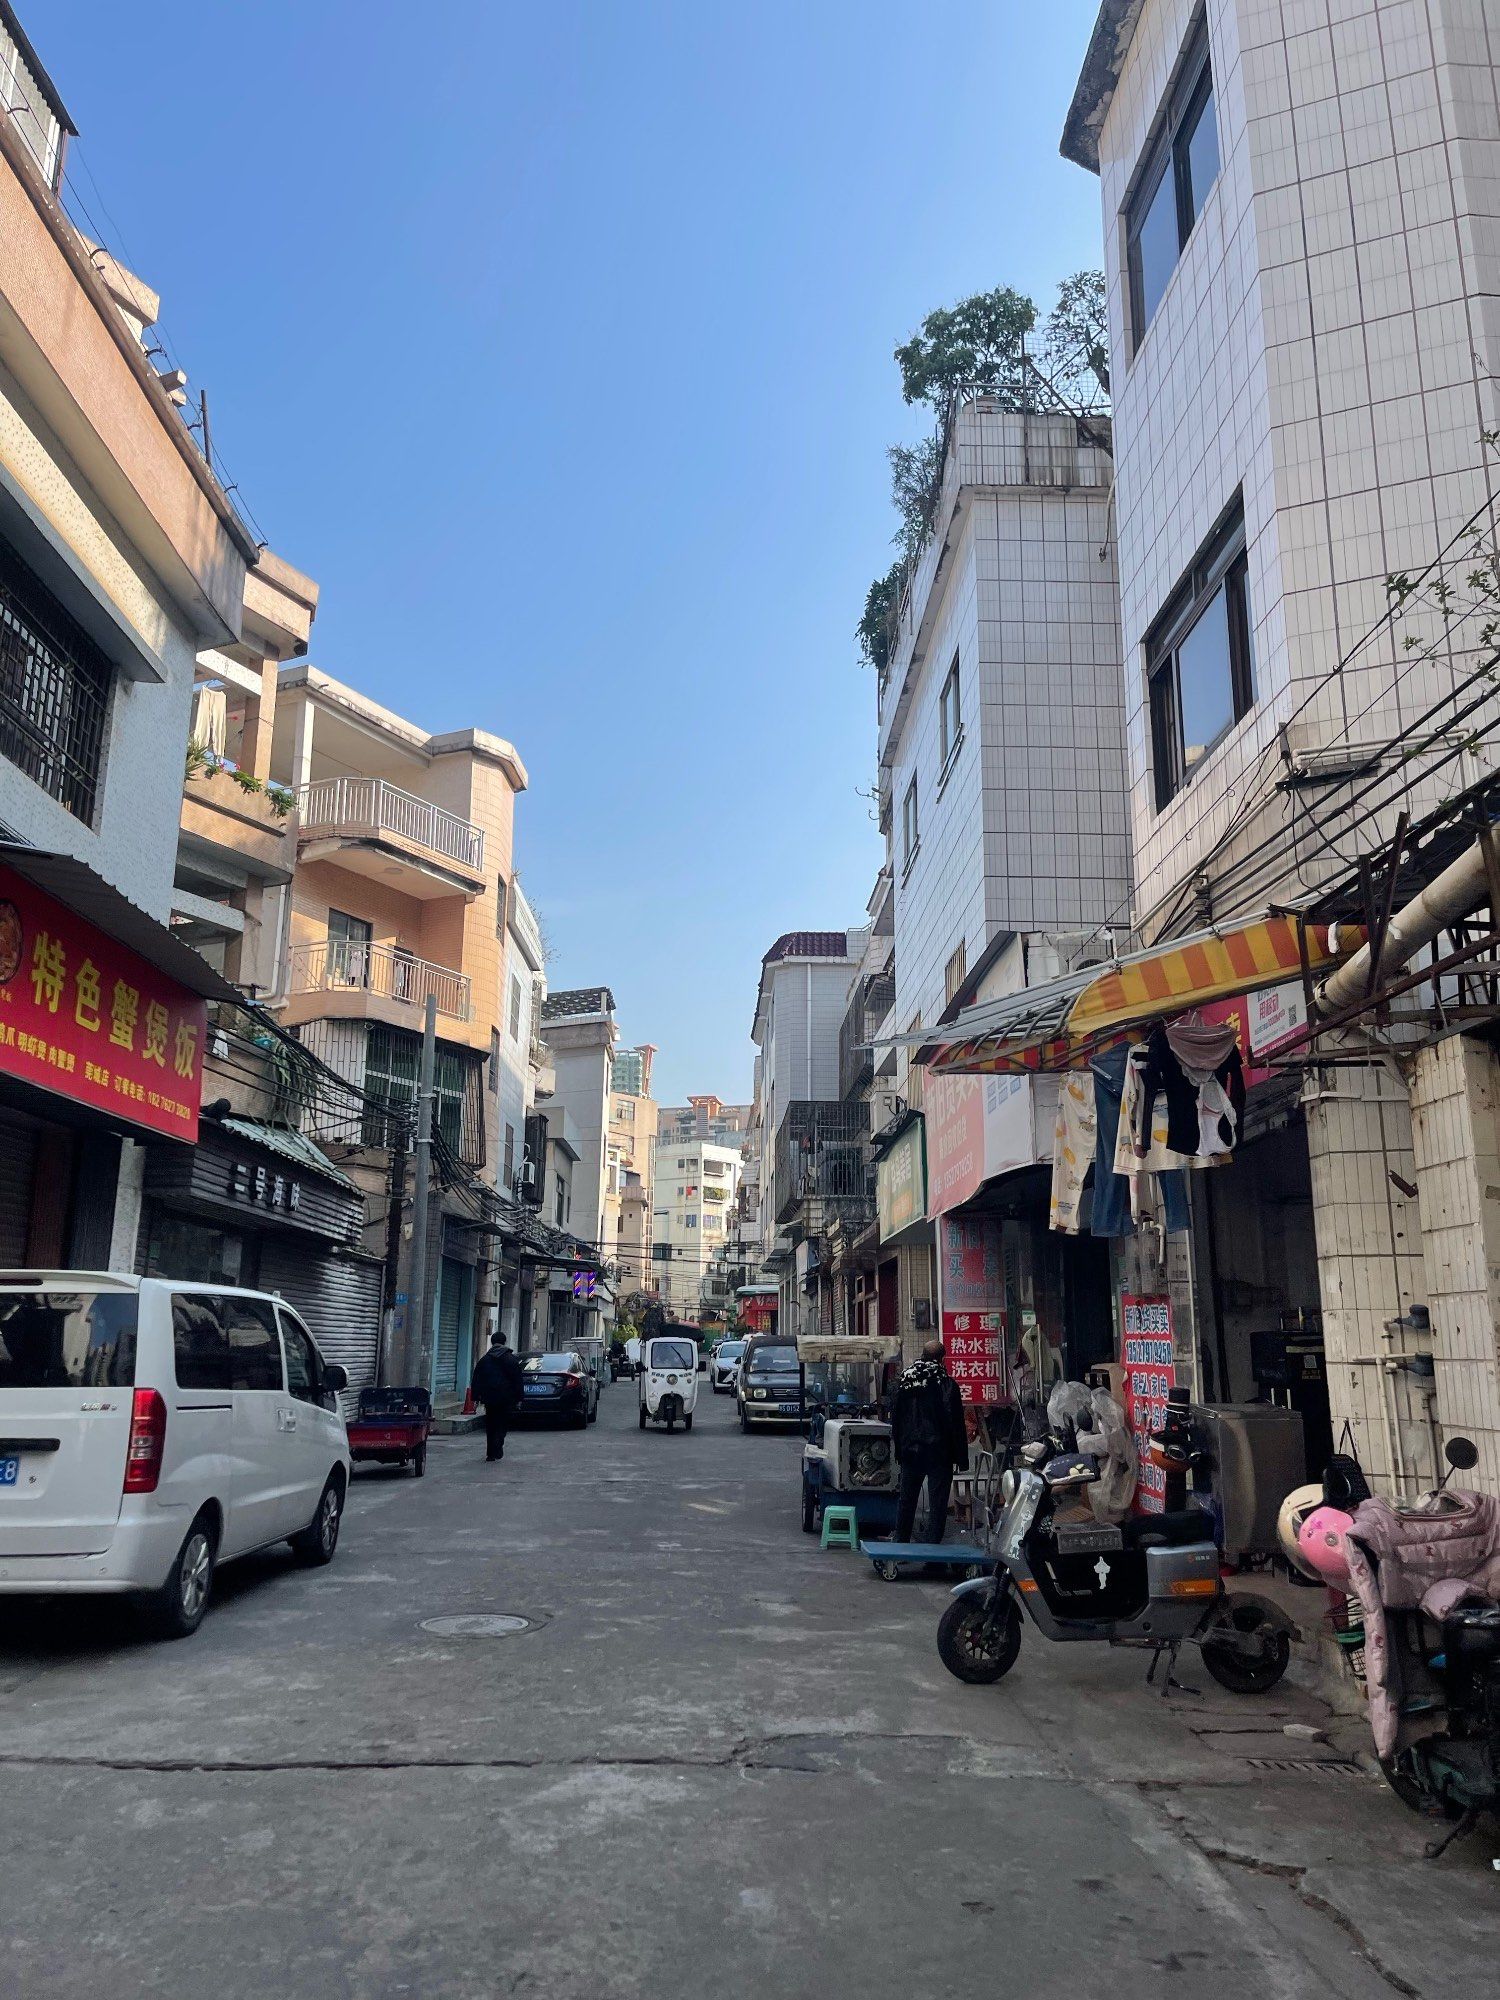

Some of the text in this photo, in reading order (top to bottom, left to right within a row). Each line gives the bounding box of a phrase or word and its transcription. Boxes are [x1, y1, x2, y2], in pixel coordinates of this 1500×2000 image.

[31, 931, 197, 1080] 特色蟹煲饭
[954, 1314, 998, 1331] 修理
[951, 1337, 1000, 1354] 热水器
[951, 1361, 999, 1378] 洗衣机
[960, 1384, 998, 1401] 空调
